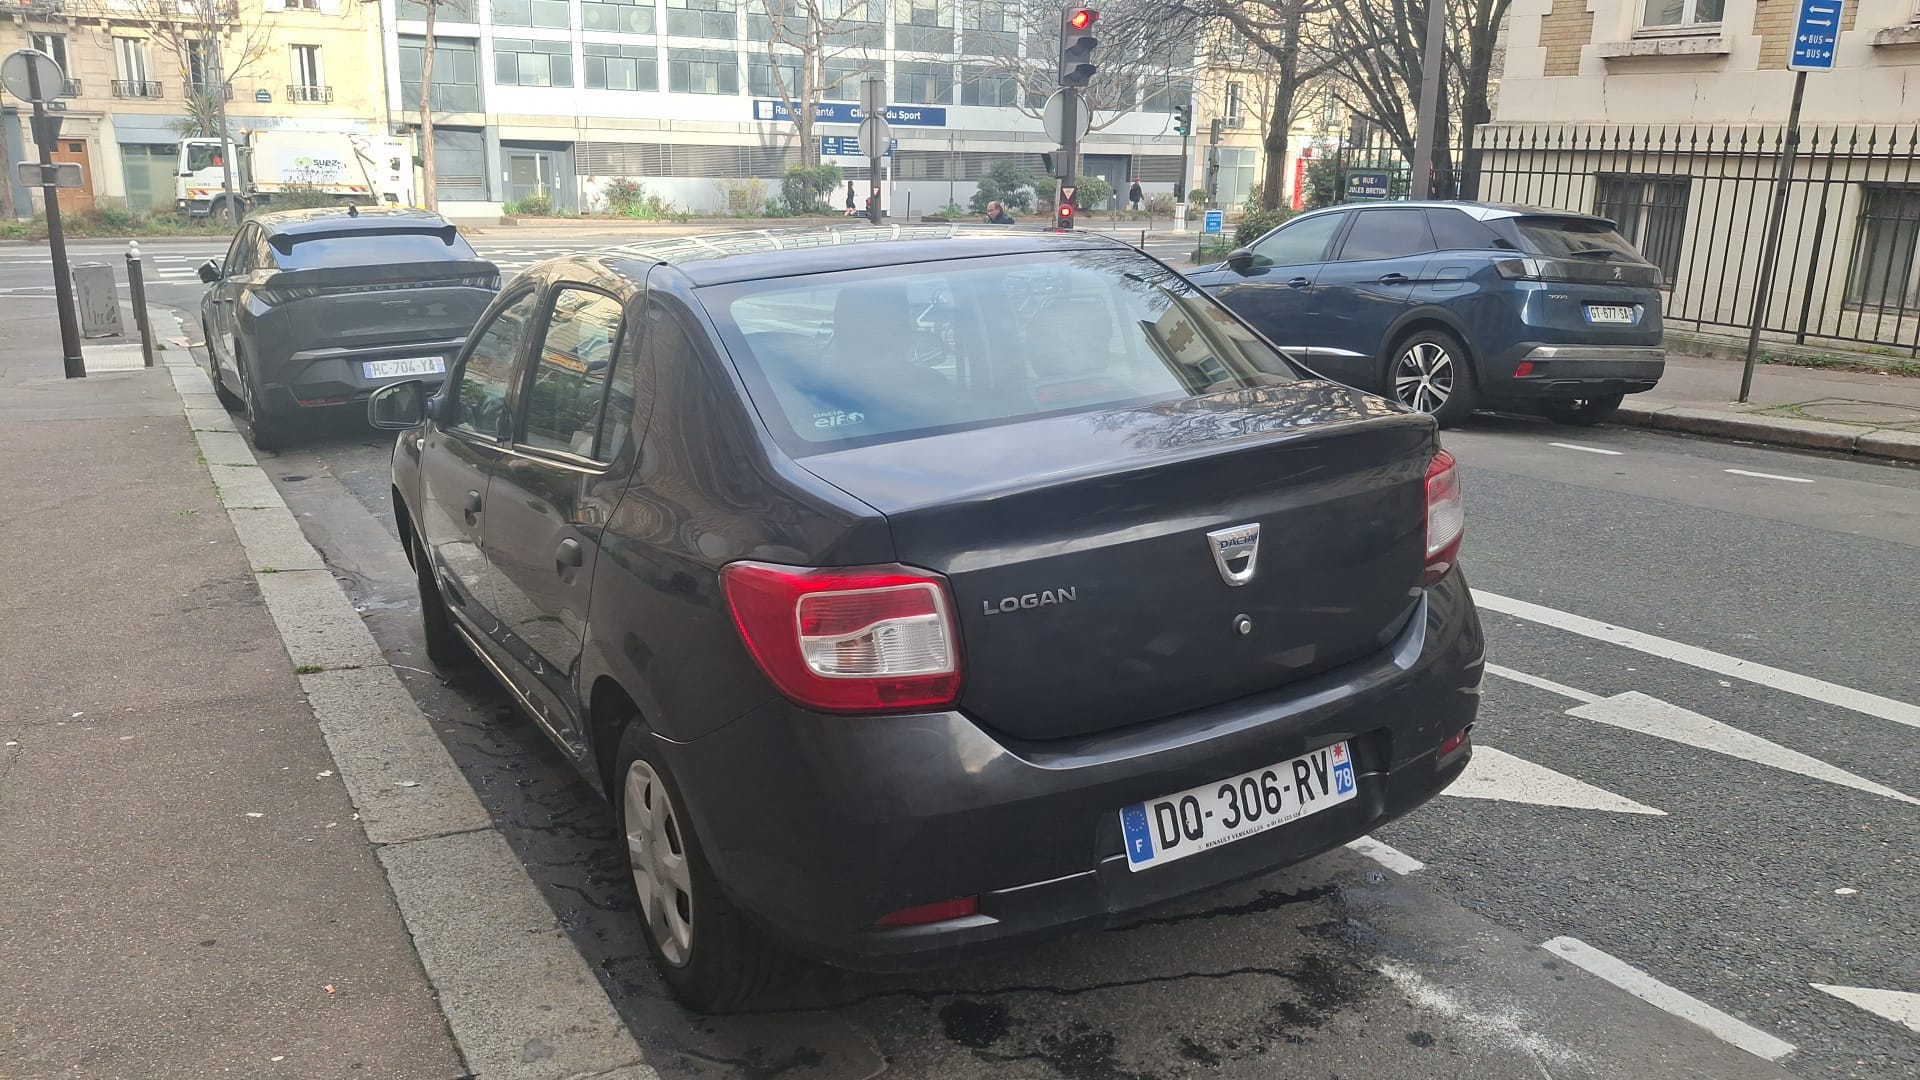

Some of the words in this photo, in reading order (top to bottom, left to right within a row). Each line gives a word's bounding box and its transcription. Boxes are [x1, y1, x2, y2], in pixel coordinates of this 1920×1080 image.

[1808, 34, 1824, 45] BUS
[1805, 49, 1821, 59] BUS
[886, 110, 897, 119] du
[899, 110, 921, 121] Sport
[1362, 176, 1375, 185] RUE
[1365, 187, 1387, 195] BRETON
[814, 414, 846, 428] elf
[1219, 533, 1257, 549] DACIA
[982, 586, 1078, 616] LOGAN
[1335, 767, 1353, 791] 78
[1154, 750, 1330, 851] DQ-306-RV
[1135, 838, 1143, 853] F
[1205, 836, 1231, 848] RENAULT
